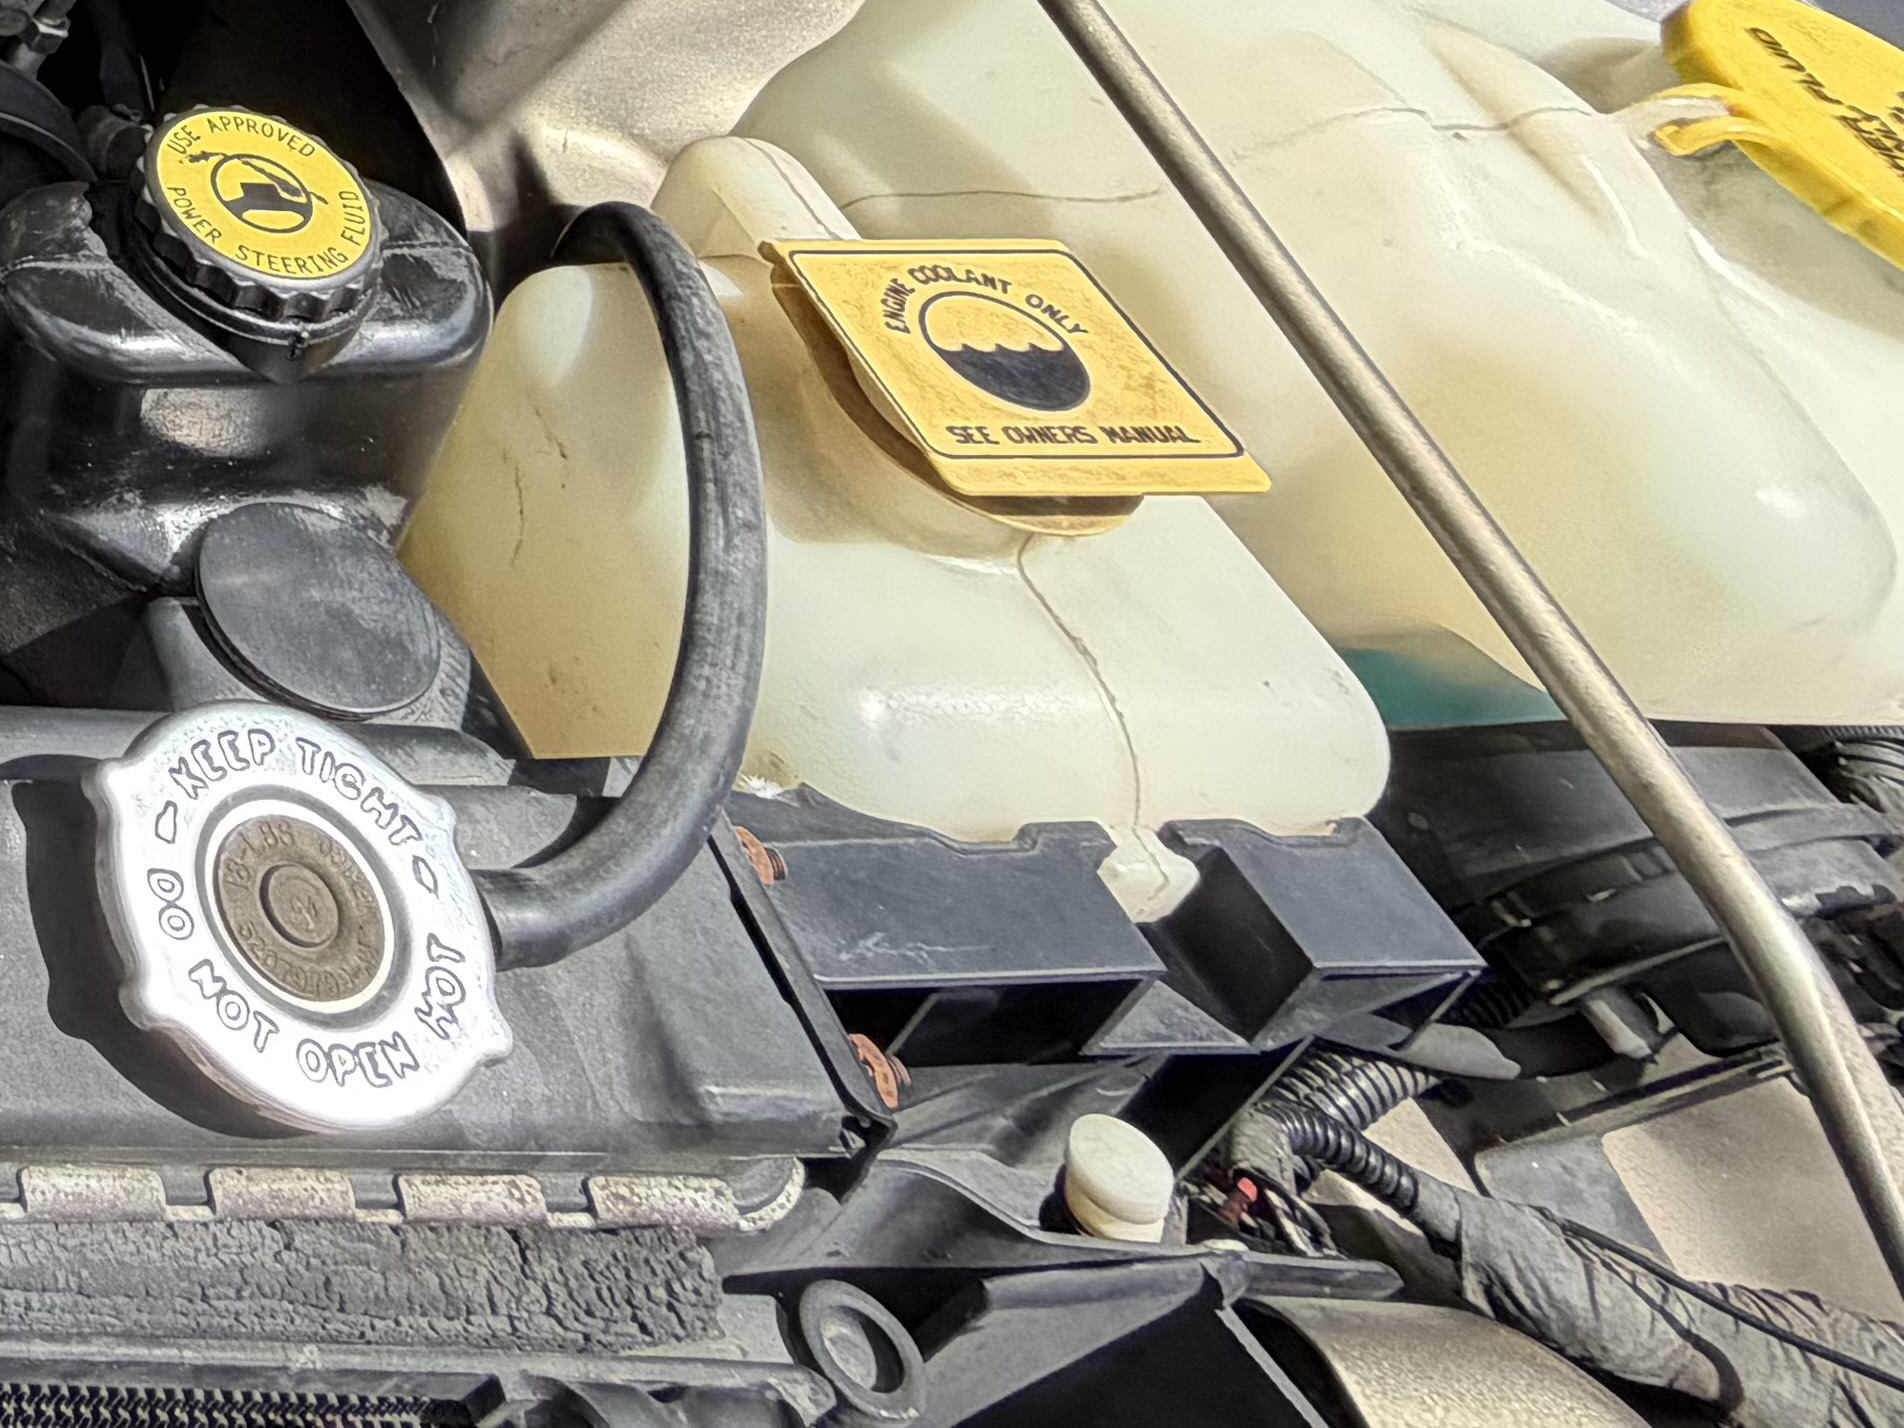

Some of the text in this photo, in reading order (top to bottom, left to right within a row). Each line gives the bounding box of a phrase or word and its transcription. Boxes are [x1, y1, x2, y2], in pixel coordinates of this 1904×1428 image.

[167, 115, 315, 158] USE APPROVED
[167, 186, 365, 274] POWER STEERING FLUID
[884, 264, 1089, 336] ENGINE COOLANT ONLY
[946, 426, 1201, 445] SEE OWNERS MANUAL
[168, 728, 422, 846] KEEP TIGHT
[148, 868, 466, 1088] DO NOT OPEN HOT
